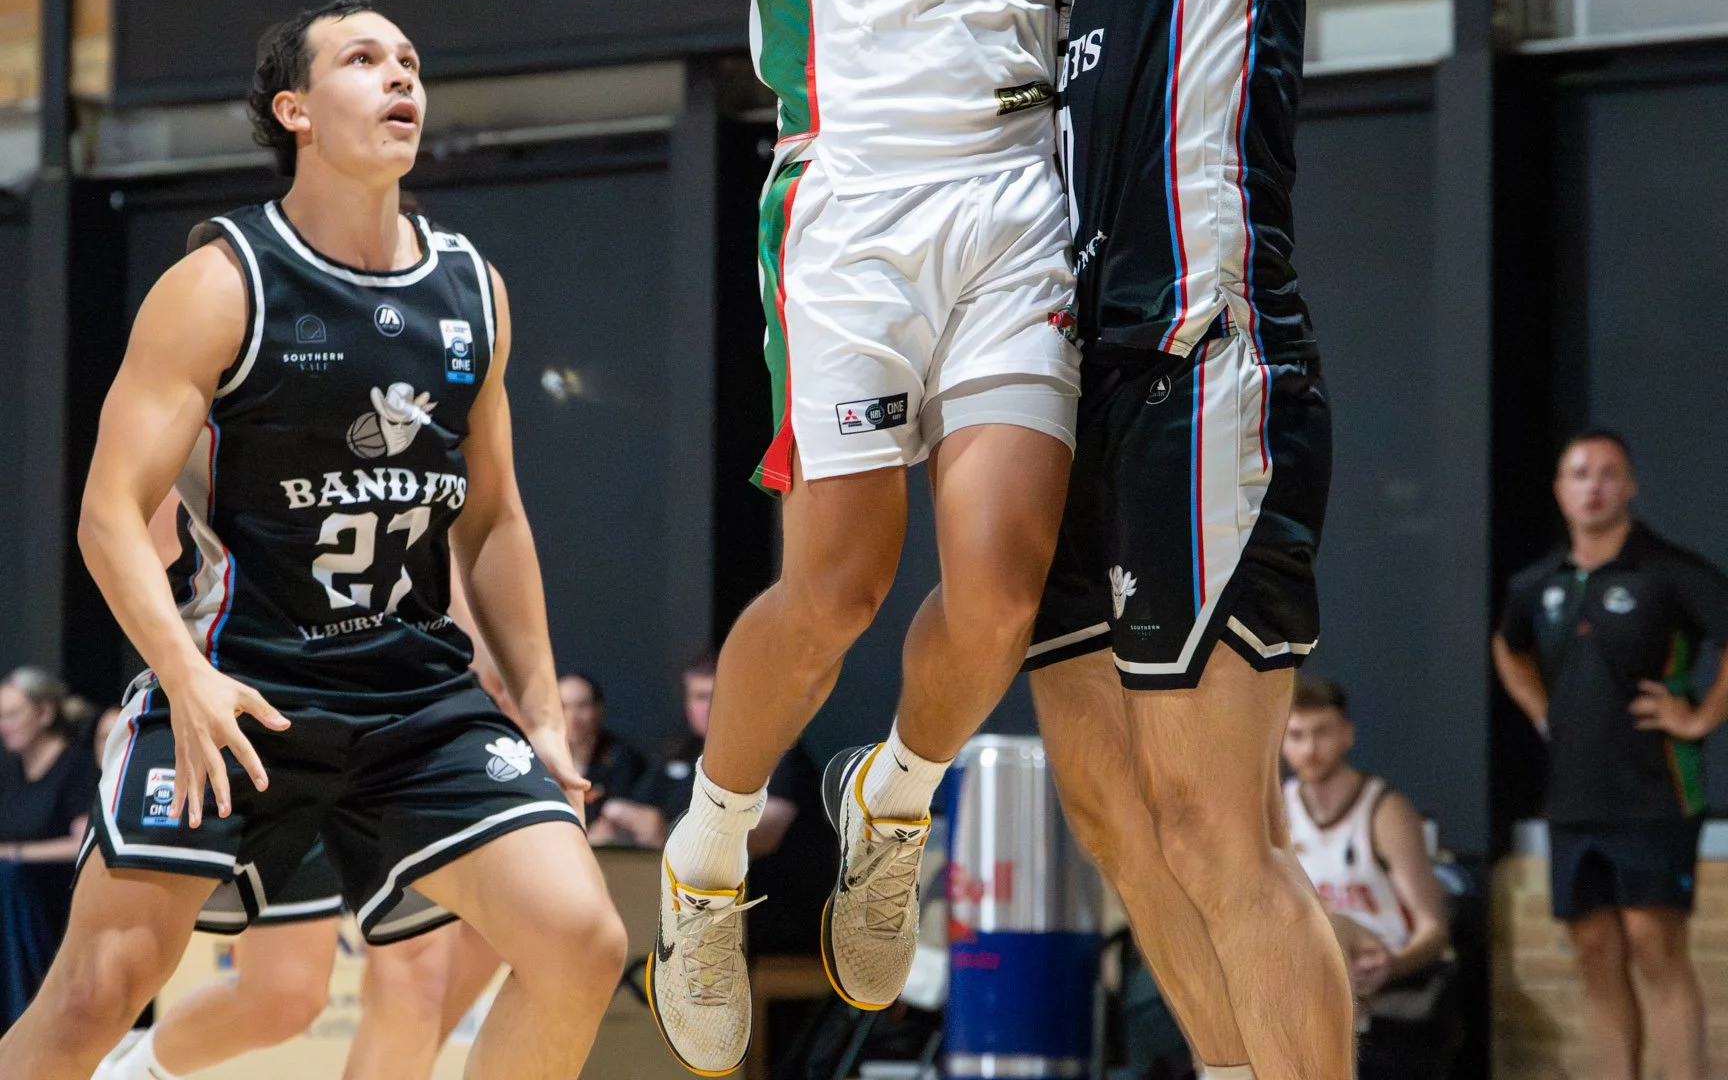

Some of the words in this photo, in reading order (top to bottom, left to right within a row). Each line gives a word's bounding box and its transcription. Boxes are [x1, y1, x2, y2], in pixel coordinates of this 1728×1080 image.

[282, 352, 344, 362] SOUTHERN
[451, 357, 471, 372] ONE
[887, 400, 904, 414] ONE
[279, 466, 467, 511] BANDITS
